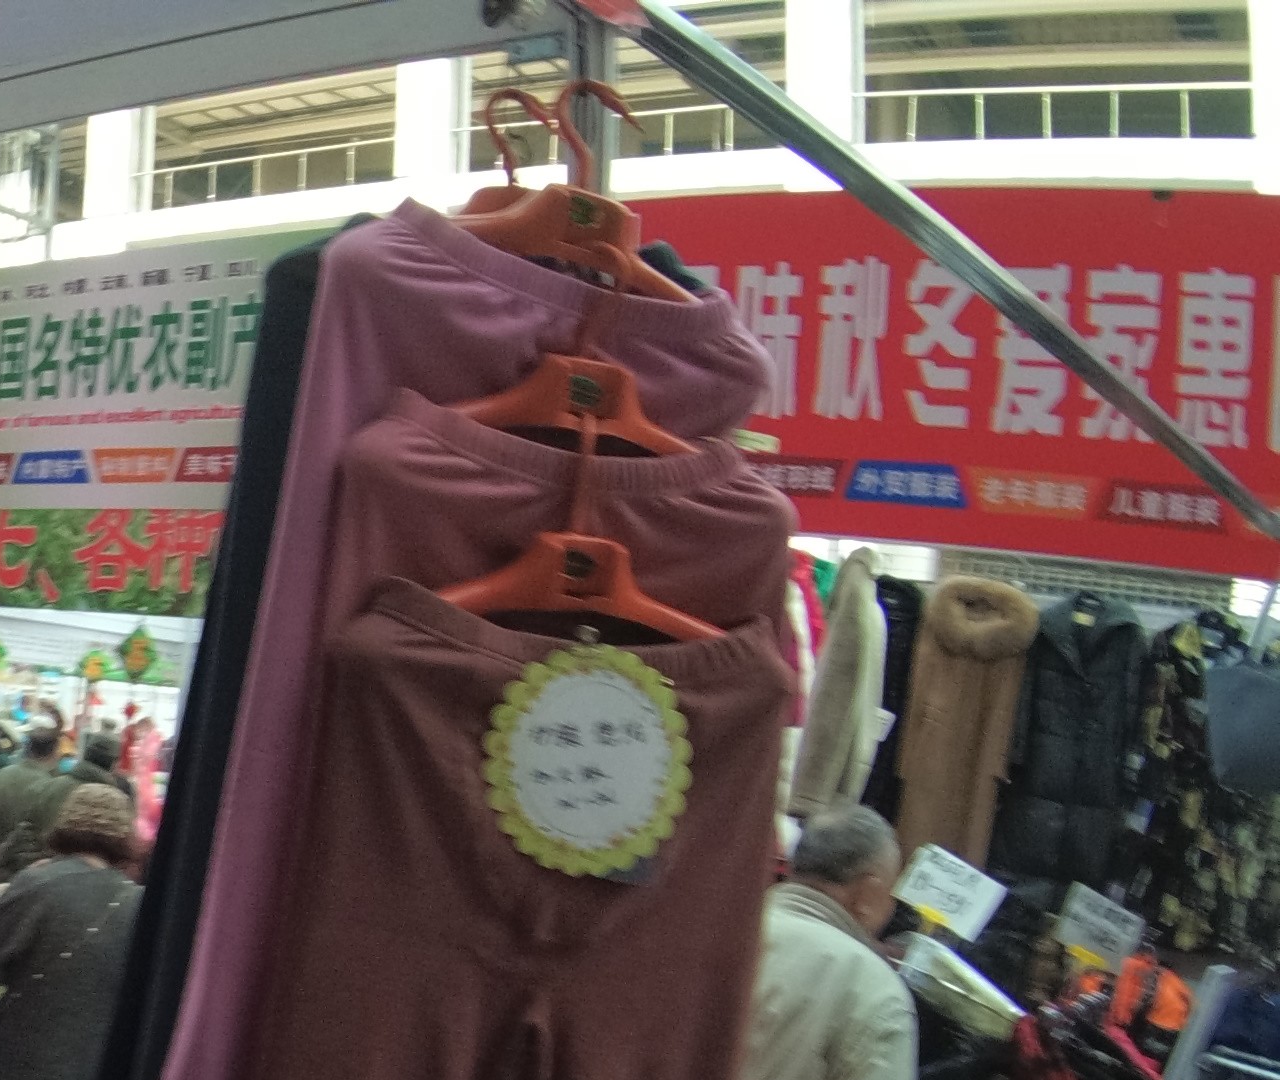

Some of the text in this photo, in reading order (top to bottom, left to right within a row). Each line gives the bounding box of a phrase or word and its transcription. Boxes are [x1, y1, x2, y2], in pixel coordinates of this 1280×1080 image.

[702, 254, 1280, 454] 味秋冬爱家惠
